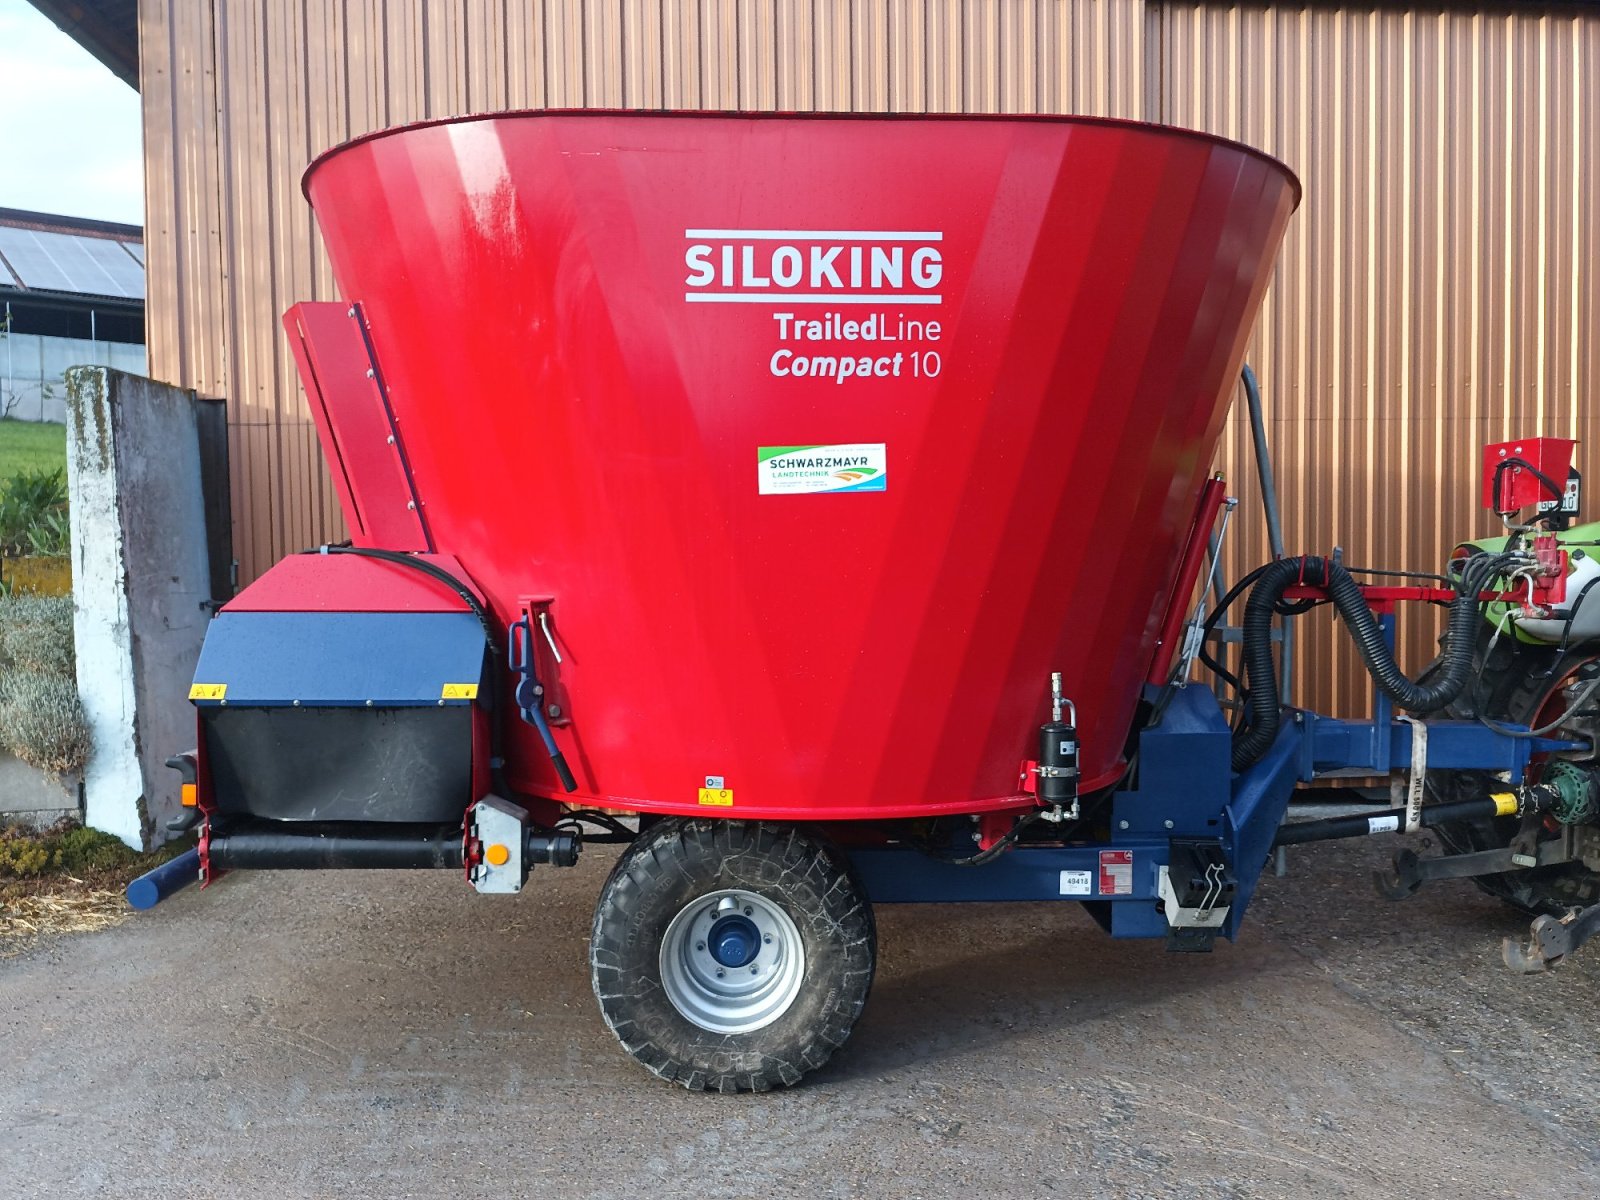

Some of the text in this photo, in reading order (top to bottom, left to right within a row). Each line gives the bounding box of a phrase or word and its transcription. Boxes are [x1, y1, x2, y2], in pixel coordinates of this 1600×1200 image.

[685, 245, 943, 288] SILOKING
[773, 312, 941, 341] TrailedLine
[770, 349, 941, 384] Compact 10
[770, 456, 868, 469] SCHWARZMAYR
